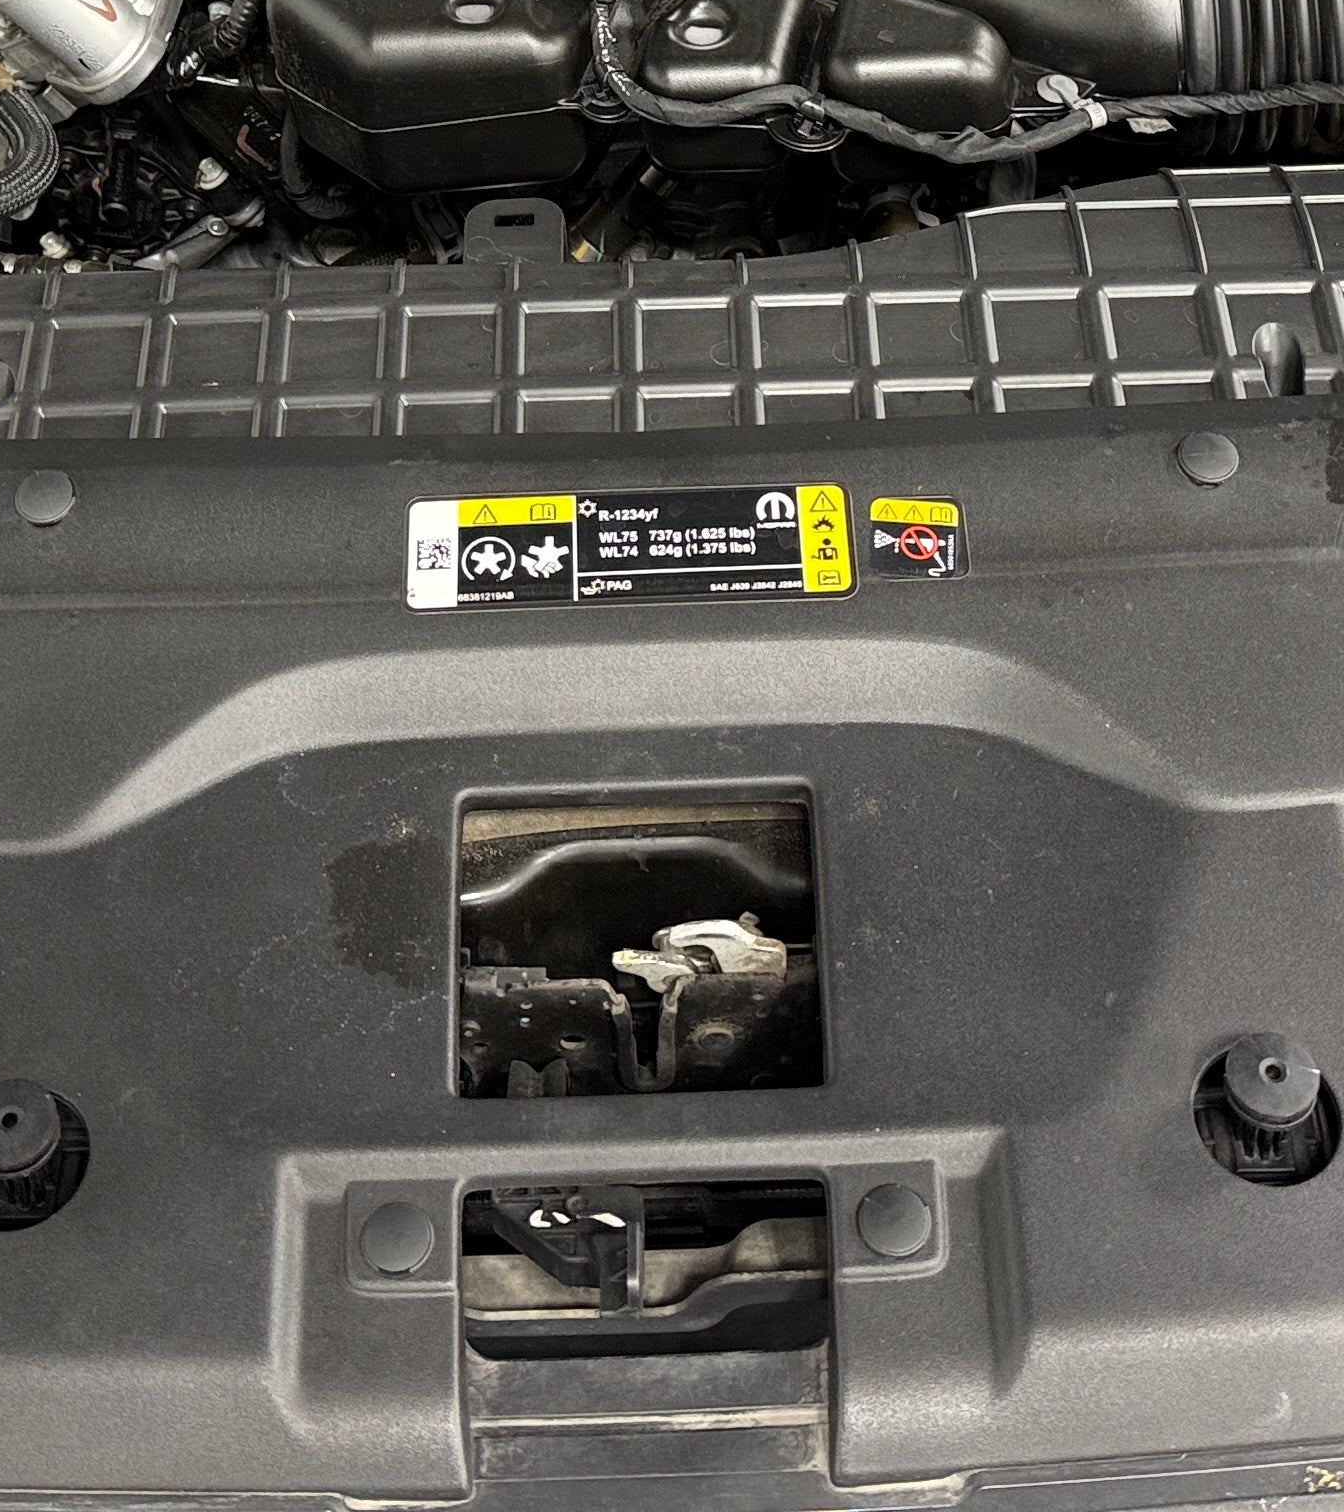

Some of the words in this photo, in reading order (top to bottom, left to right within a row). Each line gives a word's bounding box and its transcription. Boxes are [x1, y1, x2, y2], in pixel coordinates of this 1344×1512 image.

[598, 507, 660, 522] R-1234yf
[599, 531, 639, 544] WL75
[649, 529, 683, 544] 737g
[685, 528, 727, 543] (1.625
[729, 526, 756, 541] lbs)
[599, 545, 639, 559] WL74
[649, 544, 683, 558] 624g
[685, 542, 727, 558] (1.375
[729, 541, 757, 556] lbs)
[606, 580, 633, 592] PAG
